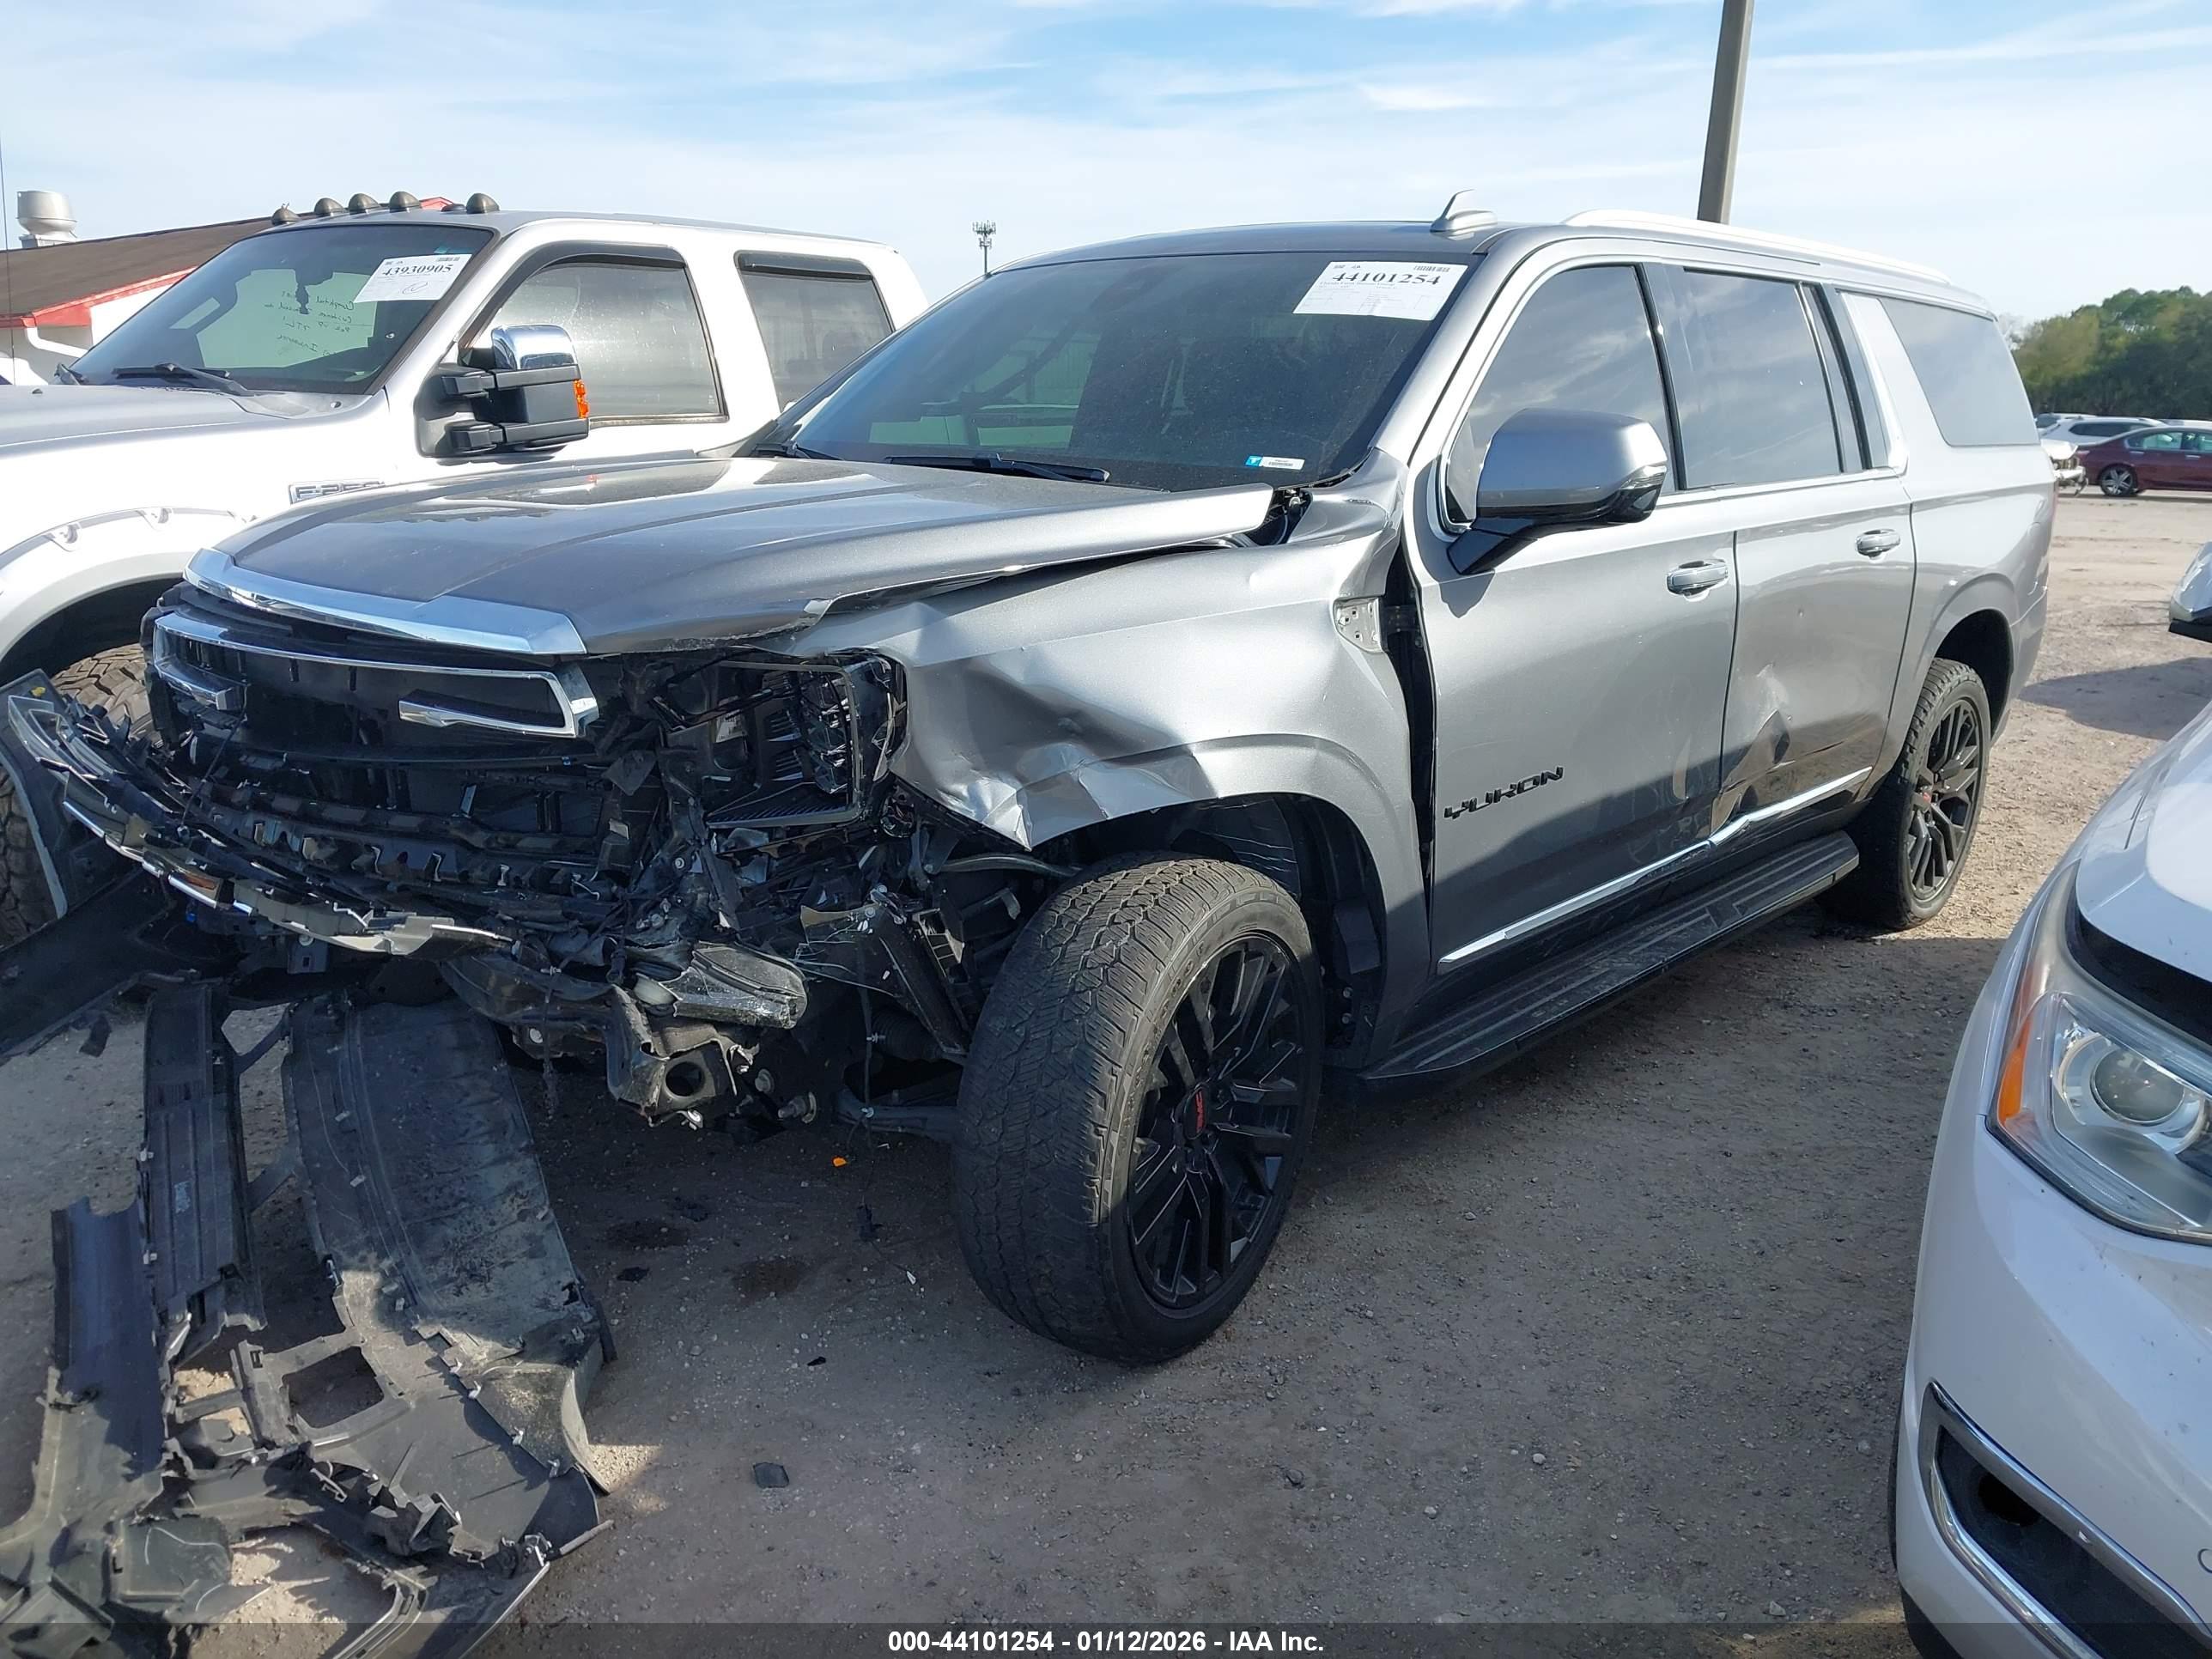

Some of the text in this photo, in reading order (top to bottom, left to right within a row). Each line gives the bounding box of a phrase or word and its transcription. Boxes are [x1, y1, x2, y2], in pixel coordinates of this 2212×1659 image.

[382, 264, 453, 276] 43930905
[1333, 272, 1441, 285] 44101254
[1444, 766, 1564, 819] YUKON
